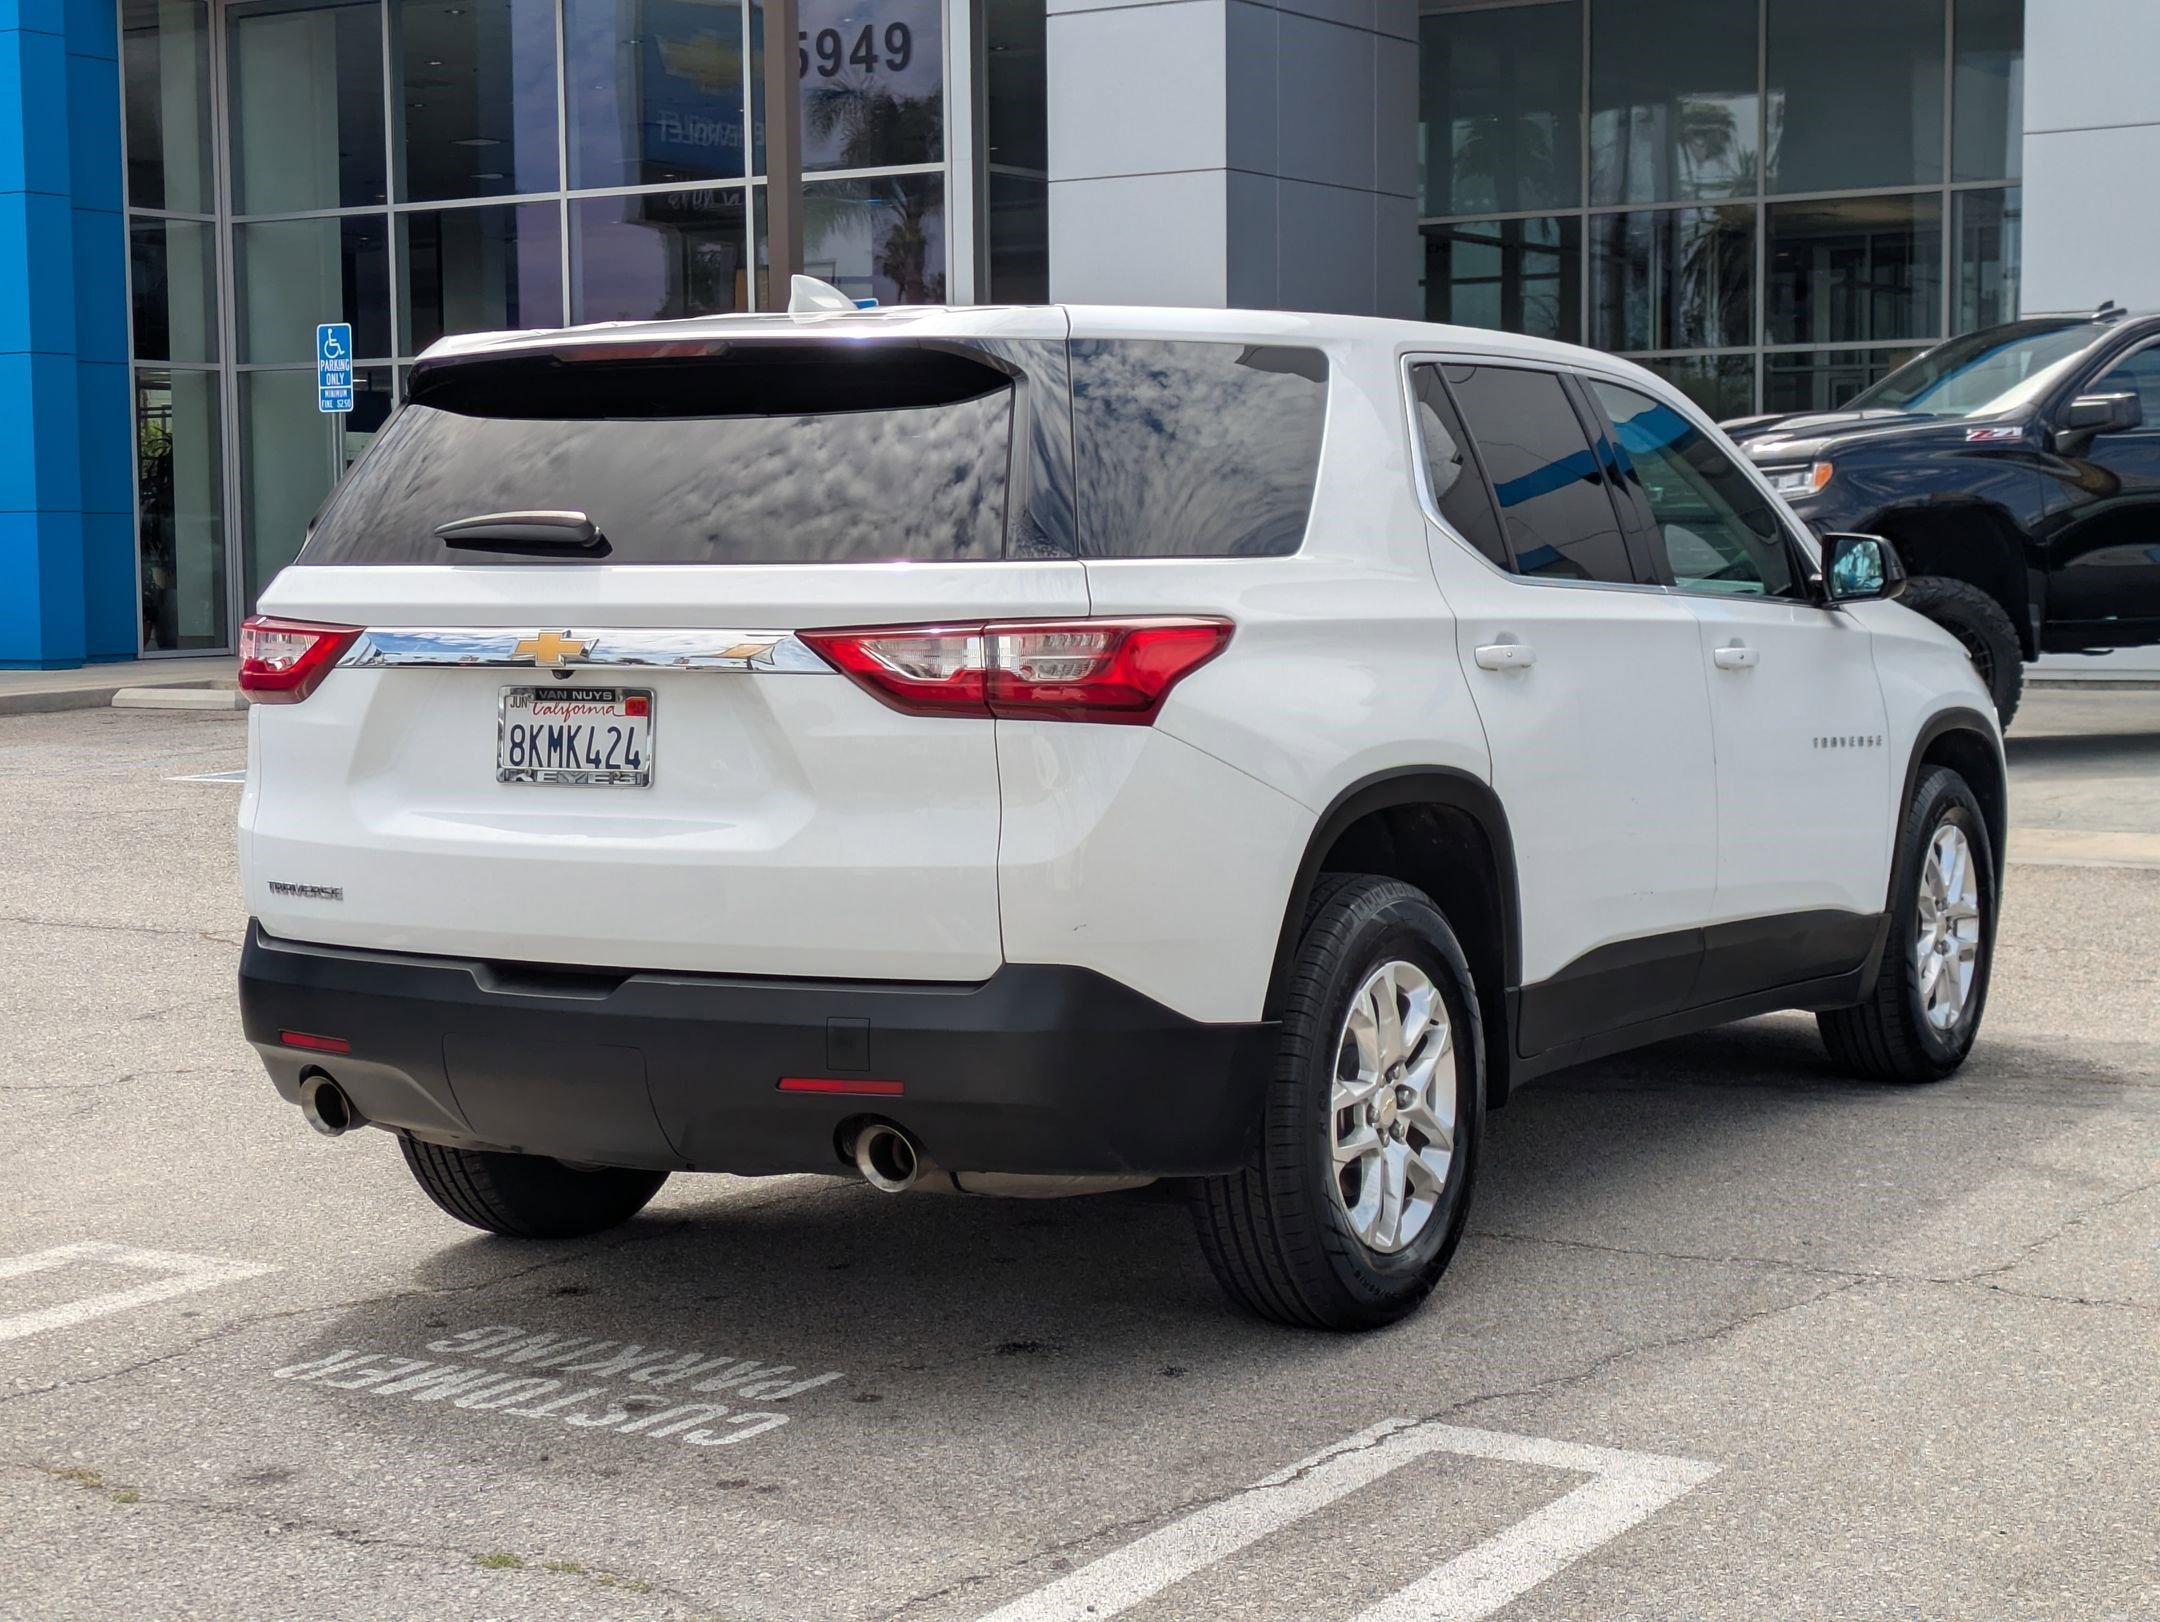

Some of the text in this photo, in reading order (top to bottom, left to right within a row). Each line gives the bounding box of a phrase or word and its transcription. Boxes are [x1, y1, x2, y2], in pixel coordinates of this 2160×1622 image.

[320, 359, 350, 372] PARKING
[326, 373, 345, 386] ONLY
[324, 389, 347, 398] MINIMUM
[321, 399, 333, 409] FINE
[538, 690, 612, 700] VAN NUYS
[510, 696, 528, 709] JUN
[532, 701, 626, 723] California
[509, 724, 641, 769] 8KMK424
[267, 880, 343, 901] TRAVERSE
[426, 1326, 846, 1401] PARKING
[274, 1349, 790, 1446] CUSTOMER
